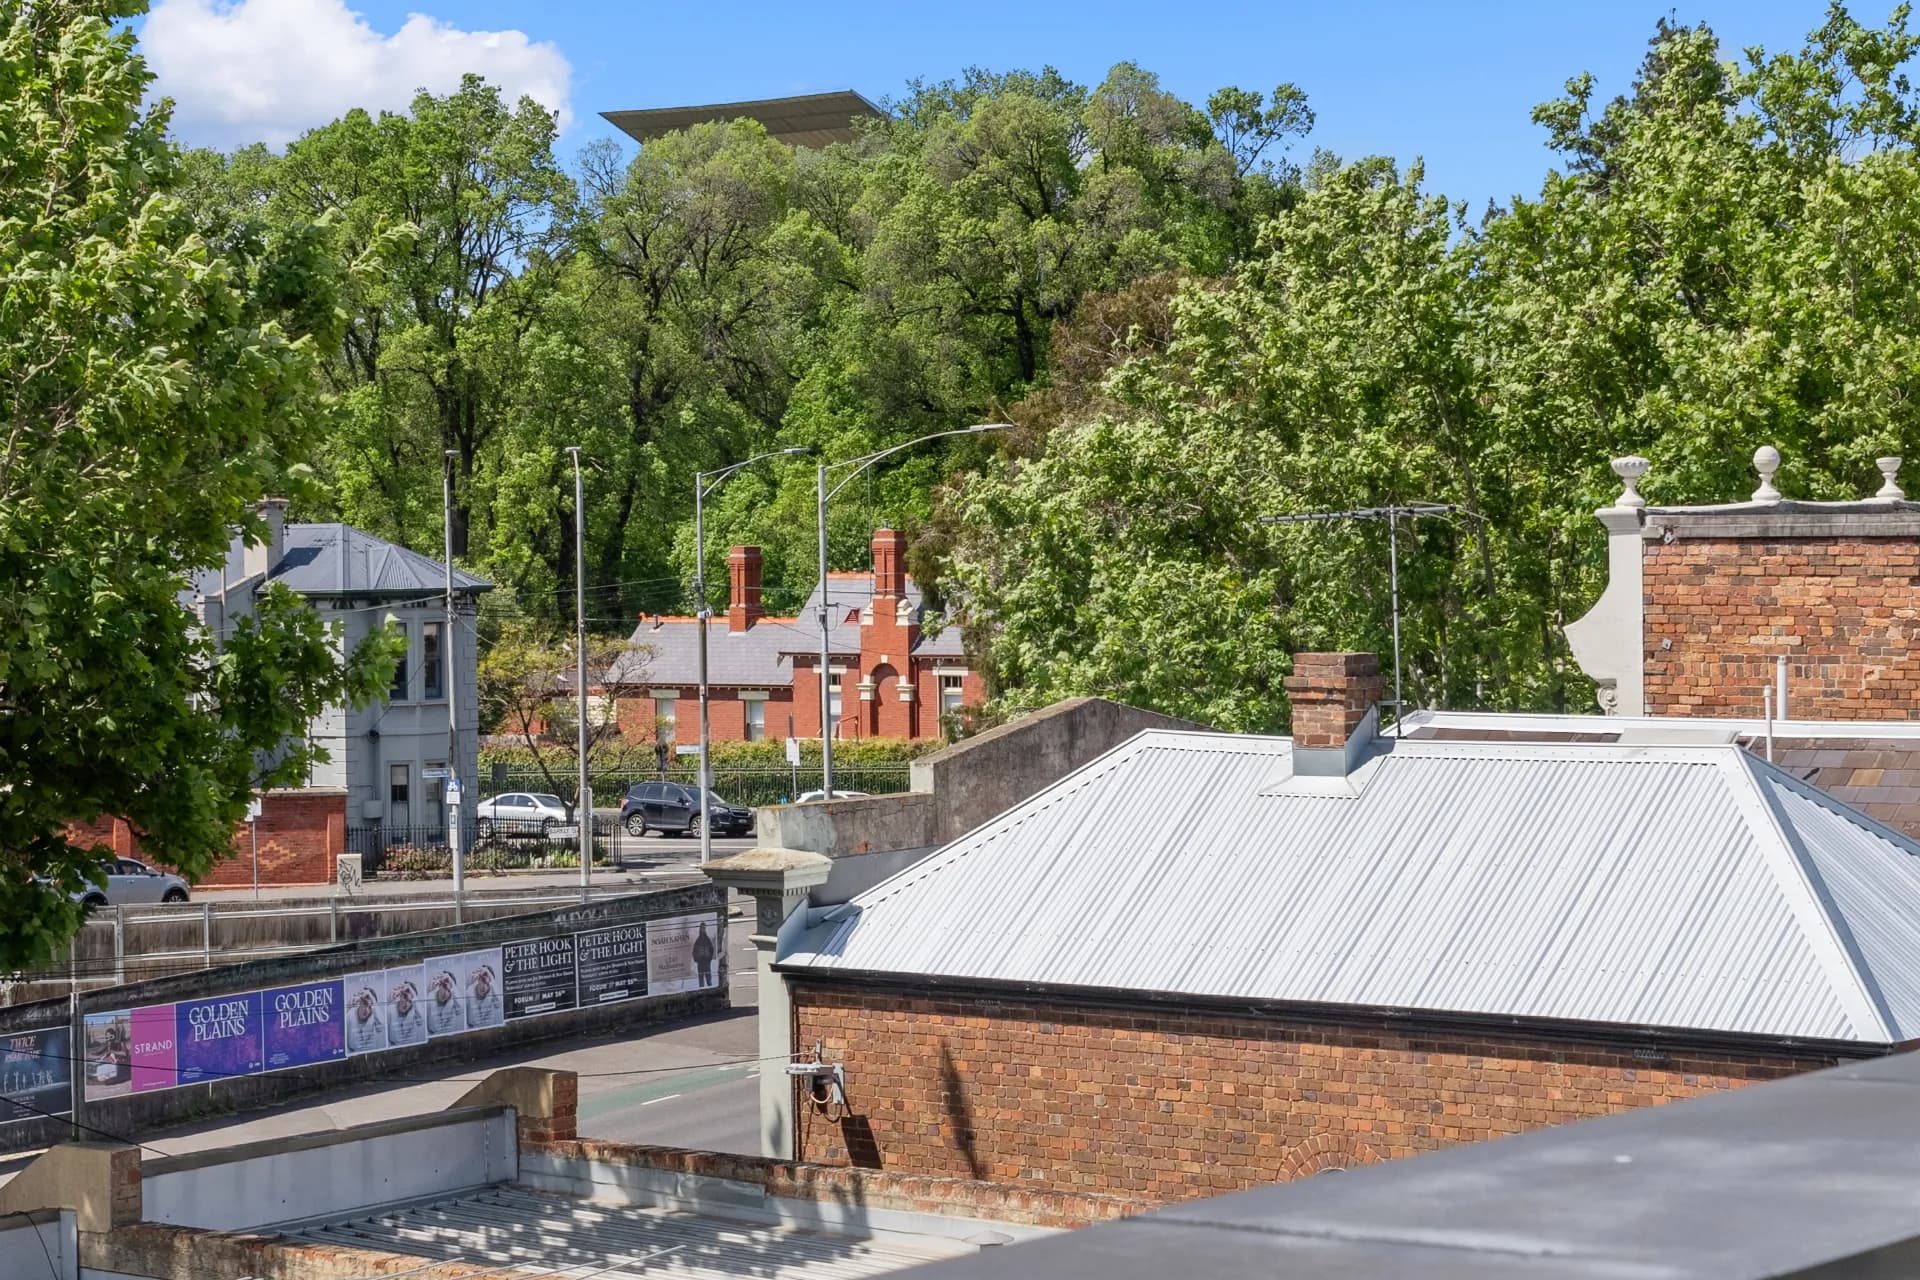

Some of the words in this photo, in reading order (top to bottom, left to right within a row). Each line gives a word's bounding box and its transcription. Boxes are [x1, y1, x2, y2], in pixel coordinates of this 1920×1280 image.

[580, 932, 610, 948] PETER
[612, 928, 643, 942] HOOK
[505, 944, 537, 960] PETER
[539, 940, 572, 954] HOOK
[579, 948, 591, 961] &
[590, 945, 612, 960] THE
[614, 940, 645, 955] LIGHT
[504, 960, 516, 973] &
[516, 957, 538, 972] THE
[540, 952, 574, 967] LIGHT
[275, 988, 333, 1012] GOLDEN
[189, 1000, 249, 1025] GOLDEN
[280, 1005, 330, 1029] PLAINS
[193, 1018, 246, 1042] PLAINS
[134, 1039, 173, 1055] STRAND
